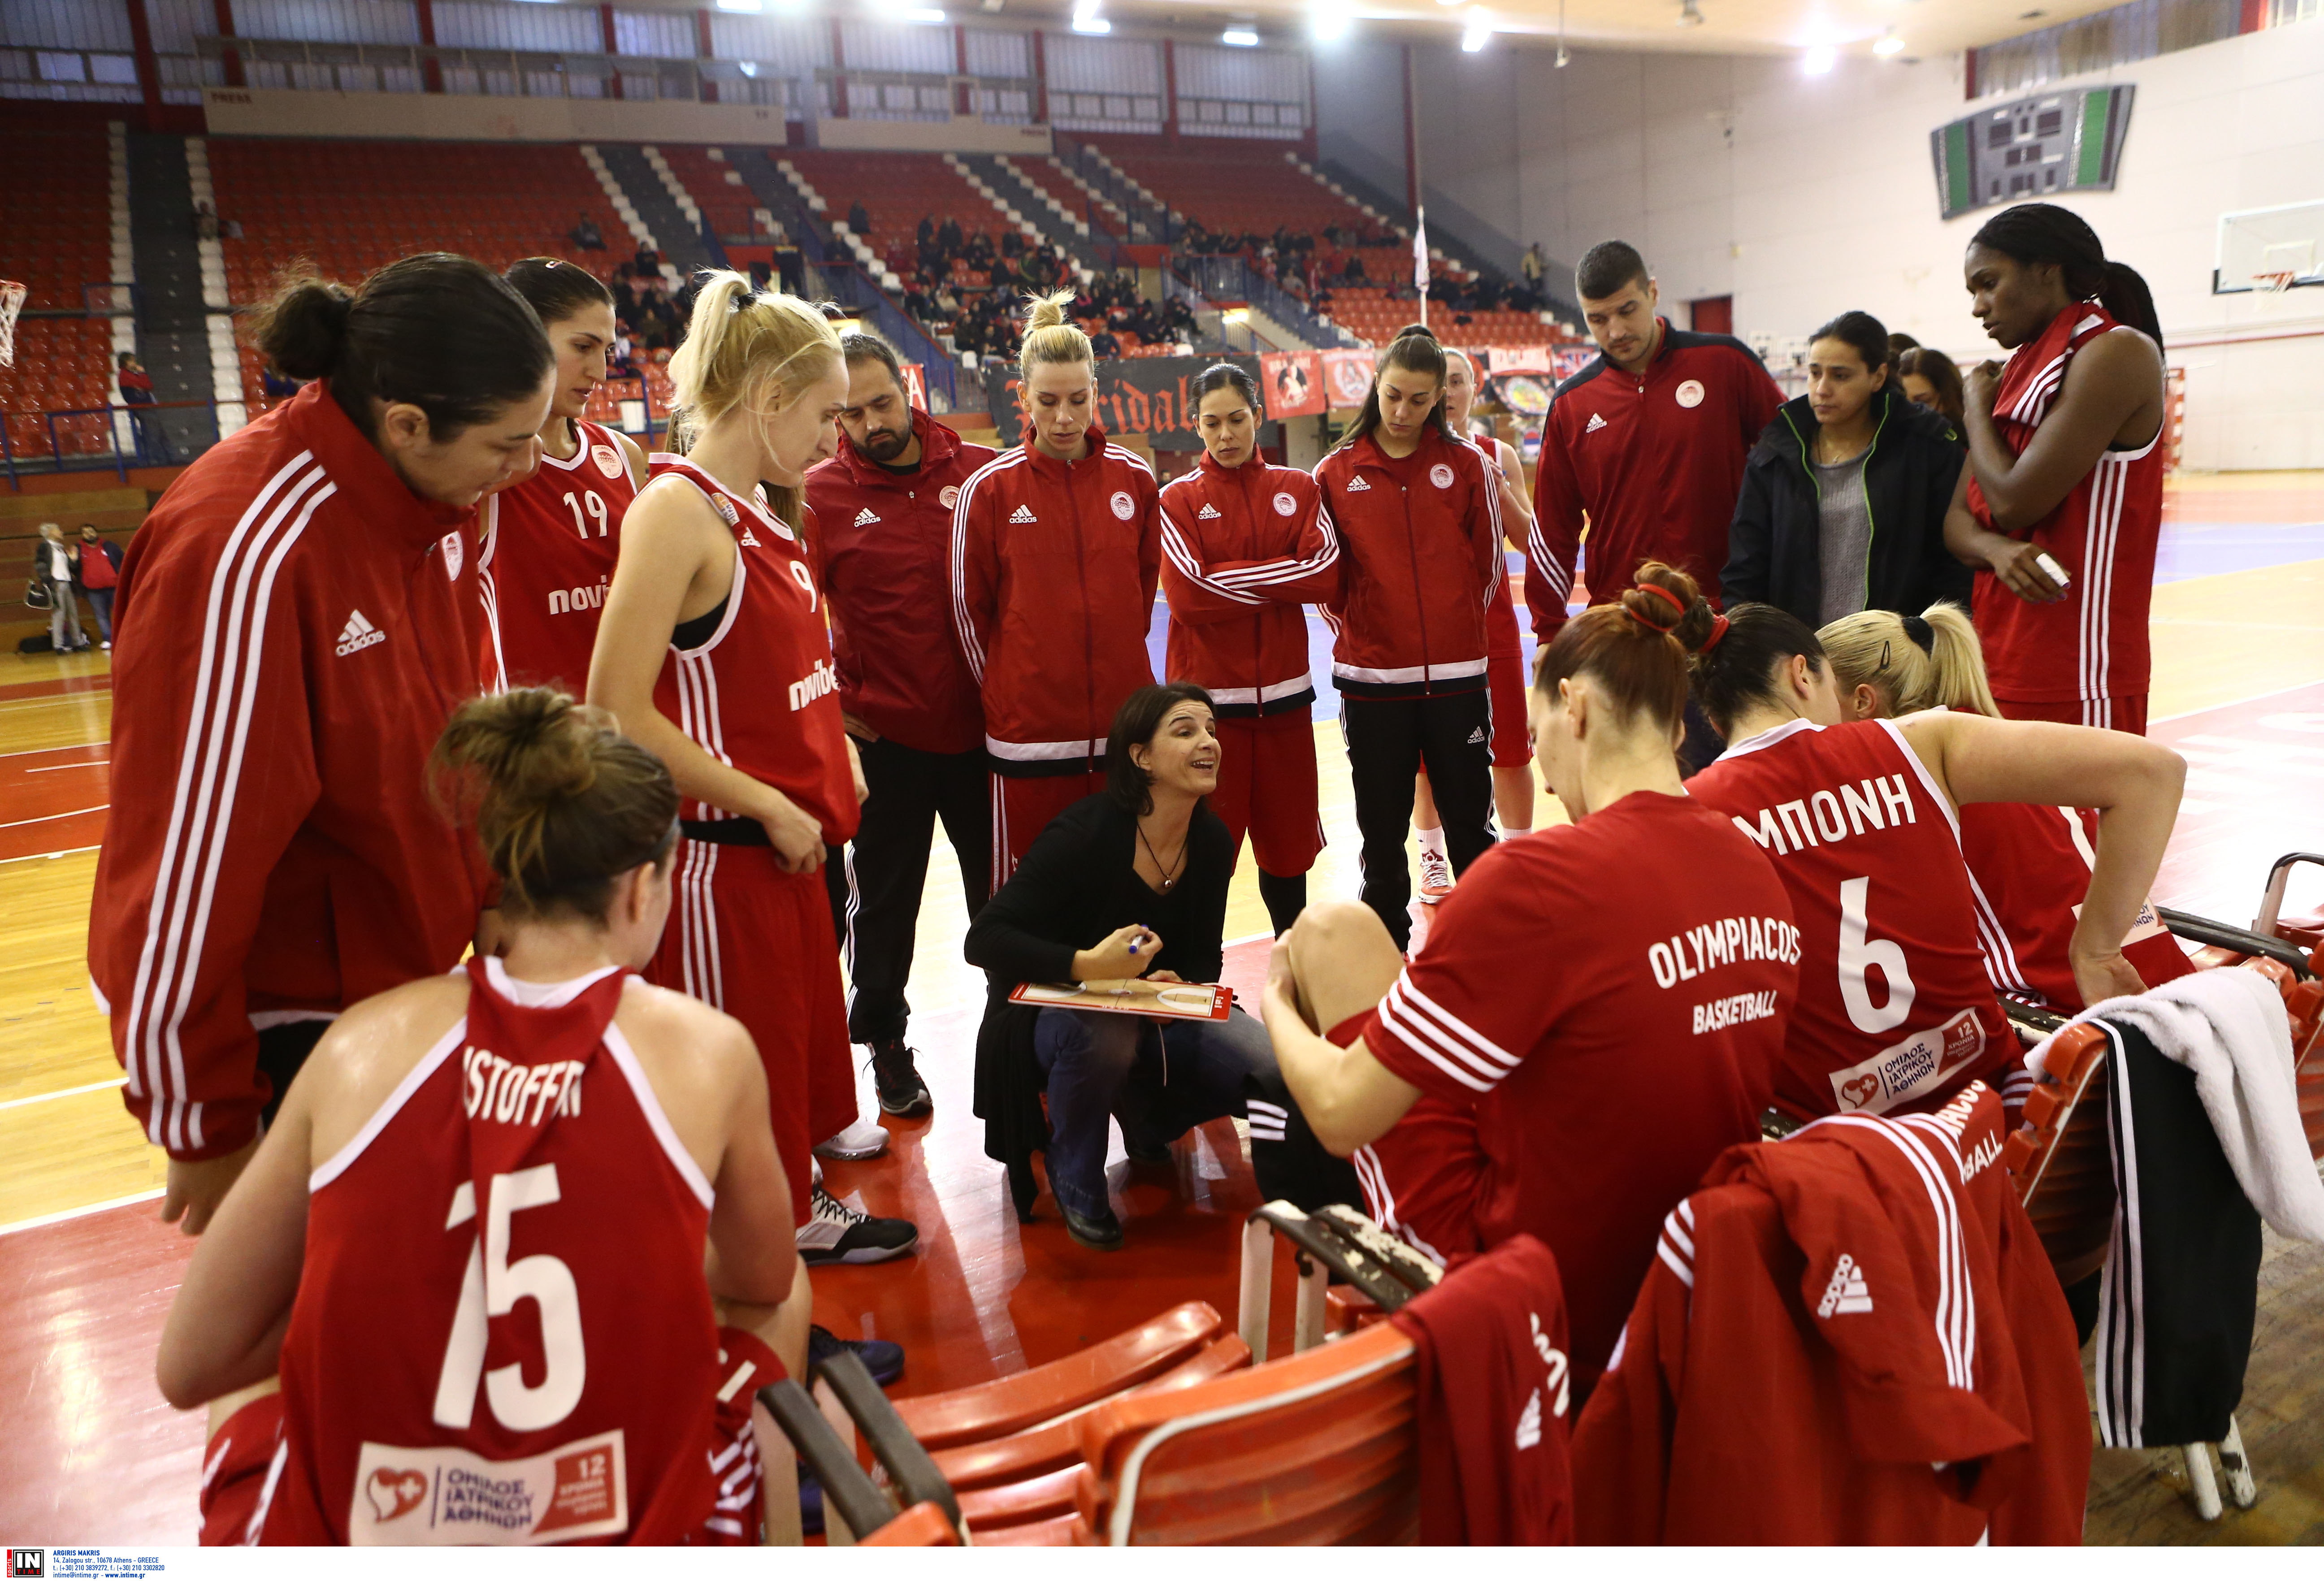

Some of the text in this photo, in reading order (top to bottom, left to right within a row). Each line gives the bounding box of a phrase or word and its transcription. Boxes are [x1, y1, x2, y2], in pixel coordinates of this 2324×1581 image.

[1586, 420, 1607, 433] adidas
[1347, 482, 1371, 492] adidas
[564, 490, 607, 539] 19
[854, 515, 881, 528] adidas
[1009, 515, 1037, 524] adidas
[1198, 511, 1222, 520] adidas
[548, 575, 610, 615] novi
[789, 560, 817, 613] 9
[336, 630, 386, 657] adidas
[1467, 735, 1485, 744] adidas
[1649, 916, 1801, 989] OLYMPIACOS
[1838, 875, 1916, 1034] 6
[1693, 991, 1777, 1035] BASKETBALL
[1957, 1021, 1973, 1039] 12
[1885, 1042, 1925, 1073] ΟΜΙΛΟΣ
[1889, 1050, 1933, 1084] ΙΑΤΡΙΚΟΥ
[1893, 1061, 1935, 1095] ΑΘΗΝΩΝ
[433, 1163, 586, 1431] 15
[578, 1454, 606, 1478] 12
[447, 1468, 524, 1495] ΟΜΙΛΟΣ
[447, 1487, 533, 1512] ΙΑΤΡΙΚΟΥ
[444, 1505, 532, 1529] ΑΘΗΝΩΝ
